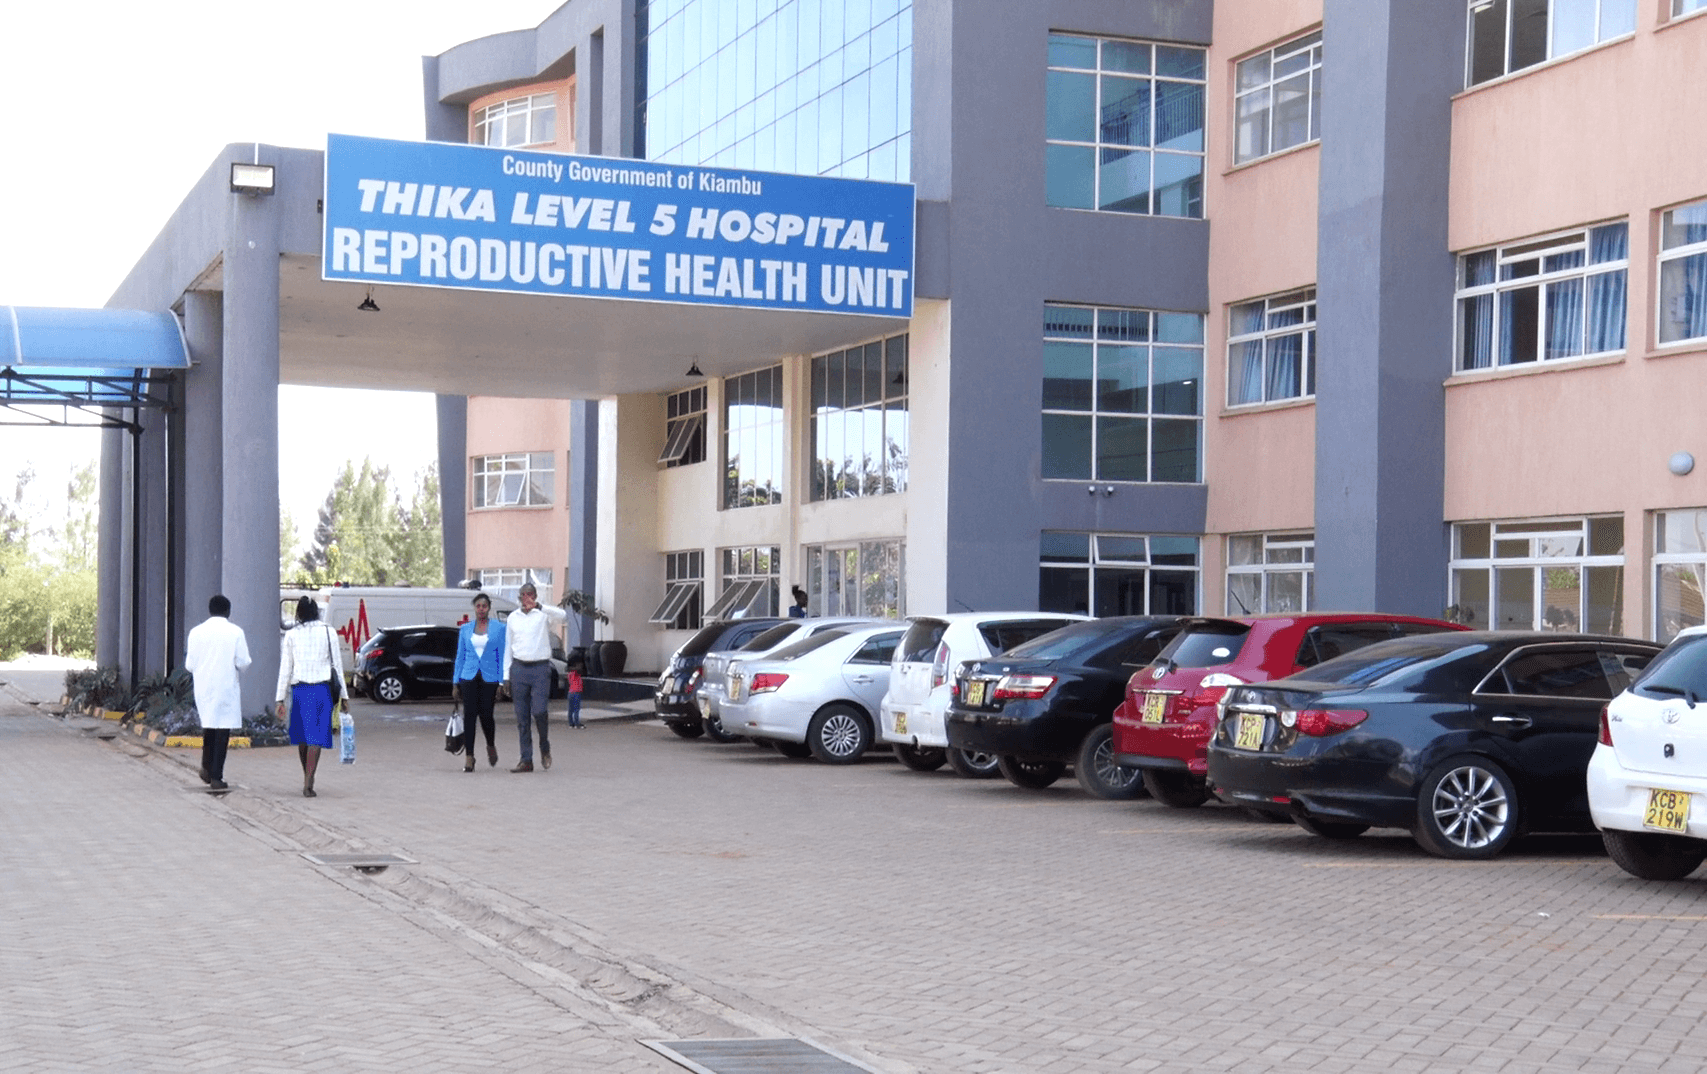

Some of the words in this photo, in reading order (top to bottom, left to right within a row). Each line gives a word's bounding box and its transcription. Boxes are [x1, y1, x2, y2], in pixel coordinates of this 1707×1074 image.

[502, 155, 563, 183] County
[569, 161, 672, 189] Government
[678, 171, 694, 190] of
[699, 172, 762, 195] Kiambu
[357, 178, 496, 222] THIKA
[510, 191, 636, 234] LEVEL
[649, 204, 678, 236] 5
[686, 206, 889, 253] HOSPITAL
[332, 227, 651, 292] REPRODUCTIVE
[665, 252, 807, 302] HEALTH
[821, 264, 908, 309] UNIT
[1646, 808, 1683, 828] 219W
[1650, 789, 1676, 809] KCB
